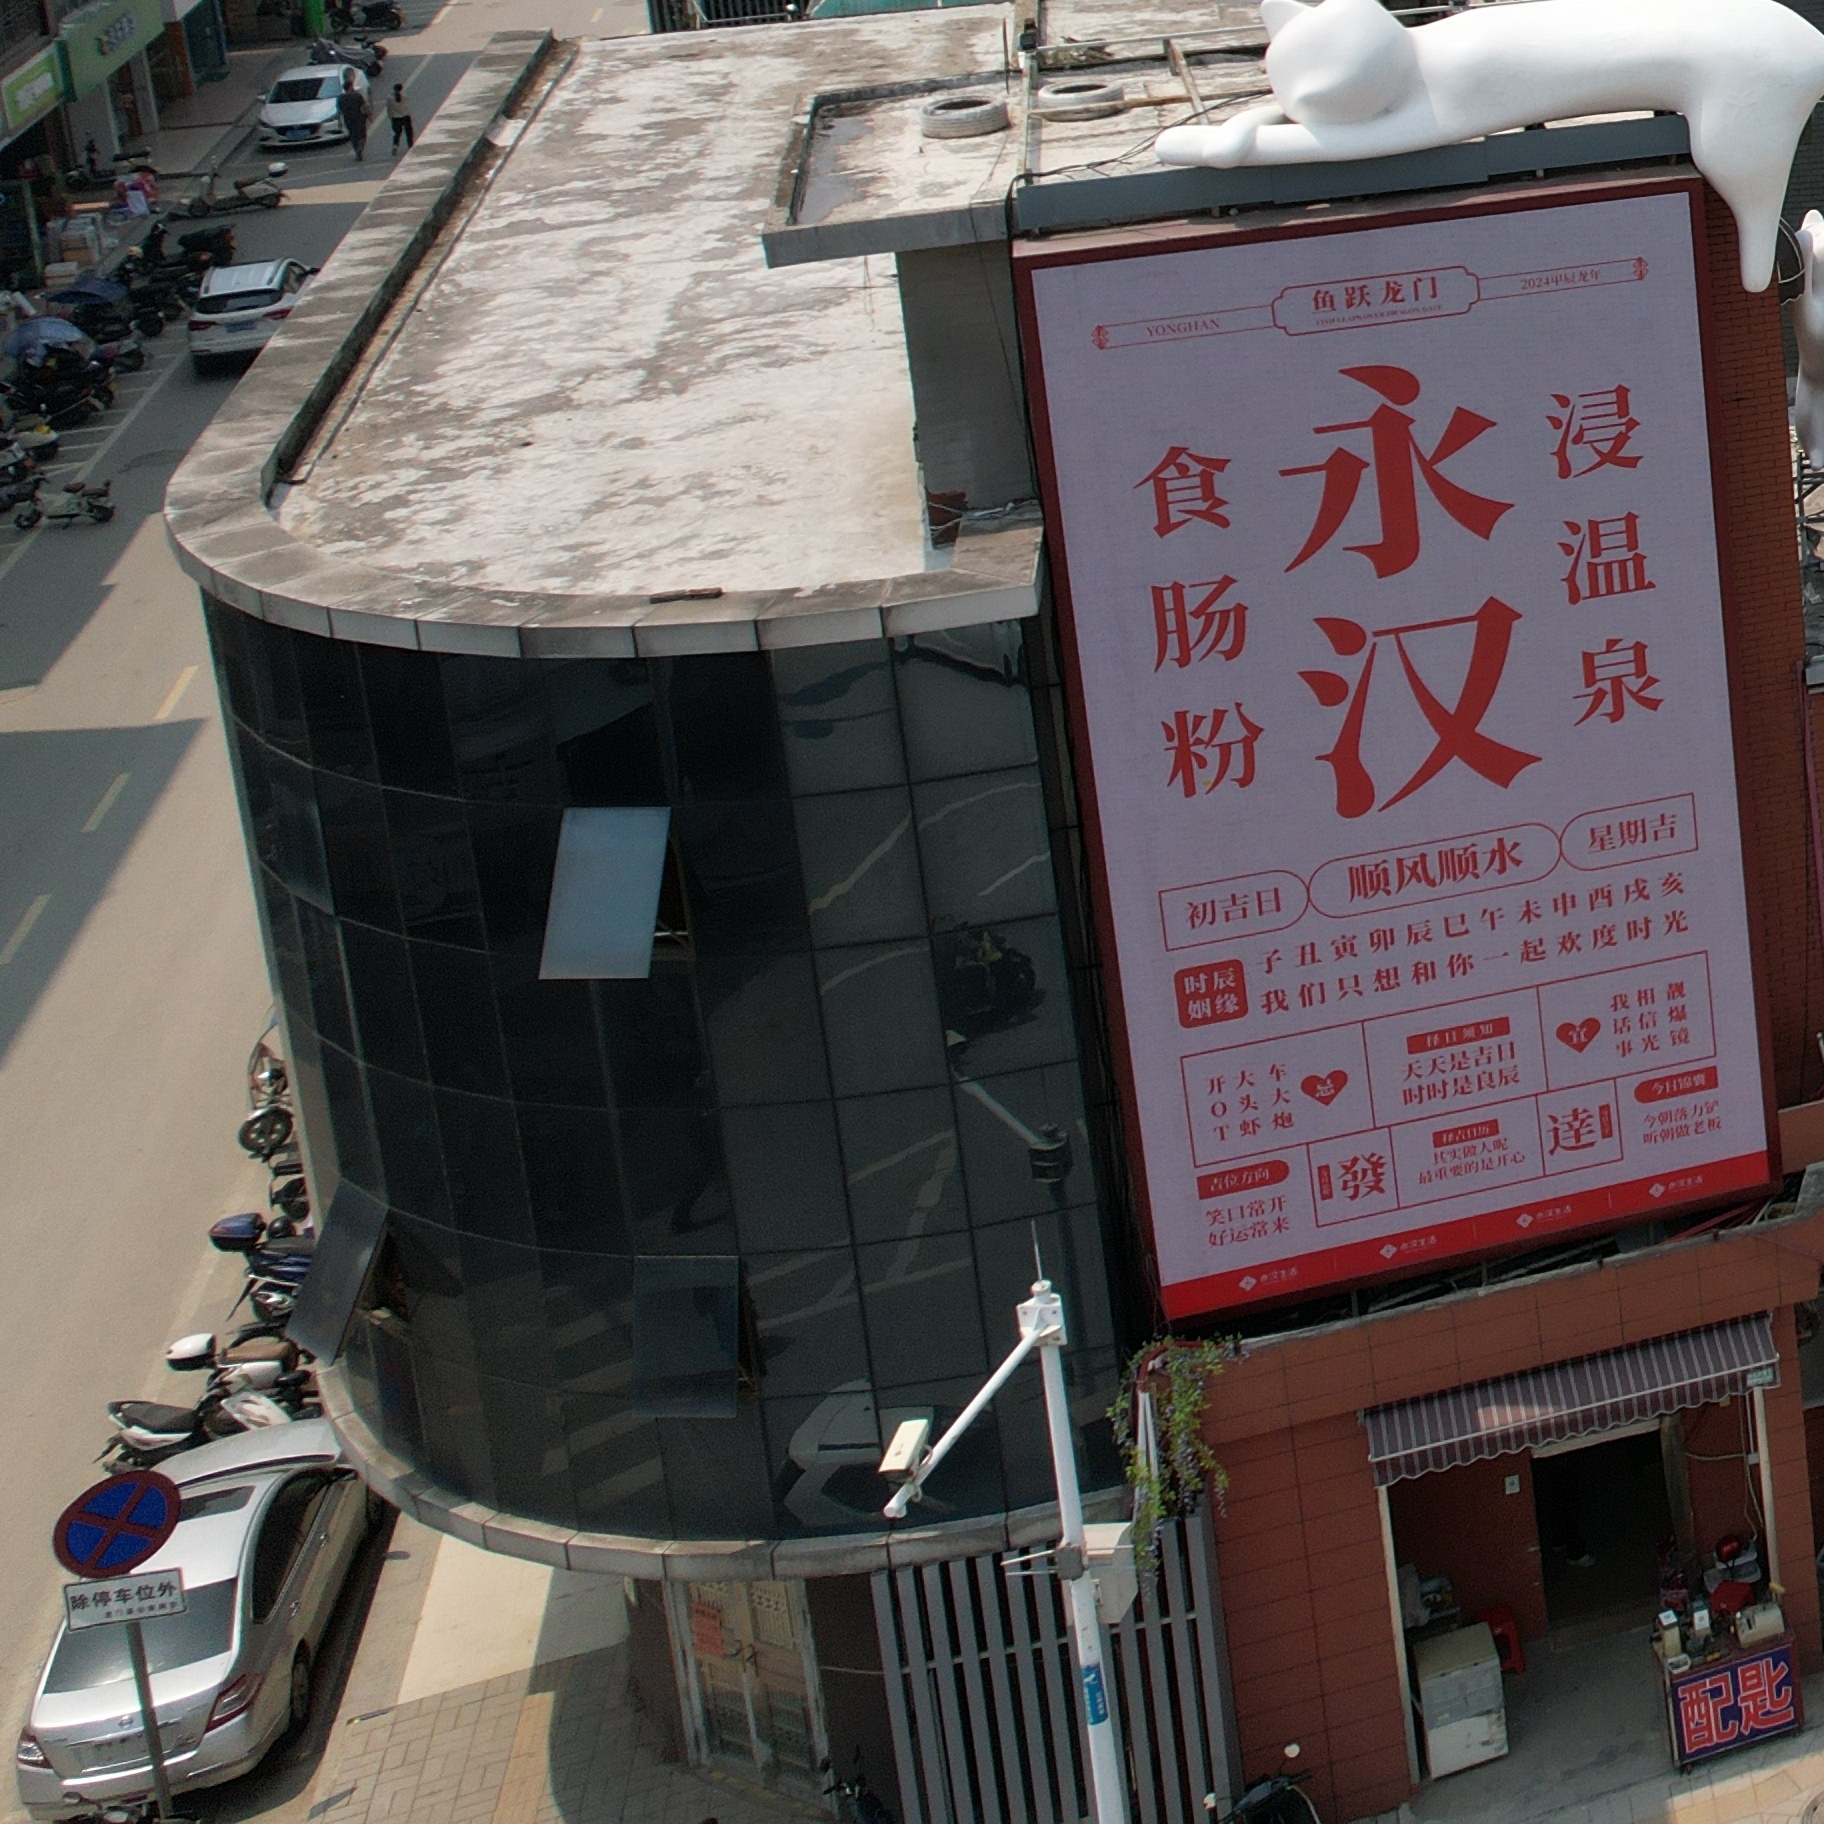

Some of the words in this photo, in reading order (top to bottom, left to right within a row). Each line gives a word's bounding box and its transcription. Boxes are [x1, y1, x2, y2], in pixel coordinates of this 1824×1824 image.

[1312, 276, 1438, 314] 鱼跃龙门
[1146, 317, 1221, 338] YONGHAN
[1546, 384, 1665, 727] 浸温泉
[1278, 365, 1543, 819] 永汉
[1133, 446, 1265, 799] 食肠粉
[1587, 813, 1677, 854] 星期吉
[1348, 837, 1523, 903] 顺风顺水
[1186, 887, 1282, 930] 初吉日
[1184, 967, 1237, 996] 时辰
[1260, 910, 1689, 1015] 我们只想和你一起欢度时光
[1187, 993, 1240, 1021] 姻缘
[1568, 1025, 1588, 1045] 宜
[1402, 1041, 1516, 1083] 天天是吉日
[1402, 1065, 1520, 1106] 时时是良辰
[1337, 1151, 1387, 1201] 發
[1419, 1151, 1525, 1185] 最重要的是开心
[1206, 1196, 1287, 1226] 笑口常开
[1208, 1216, 1290, 1247] 好运常来
[70, 1579, 177, 1611] 除停车位外
[1678, 1657, 1795, 1755] 配匙
